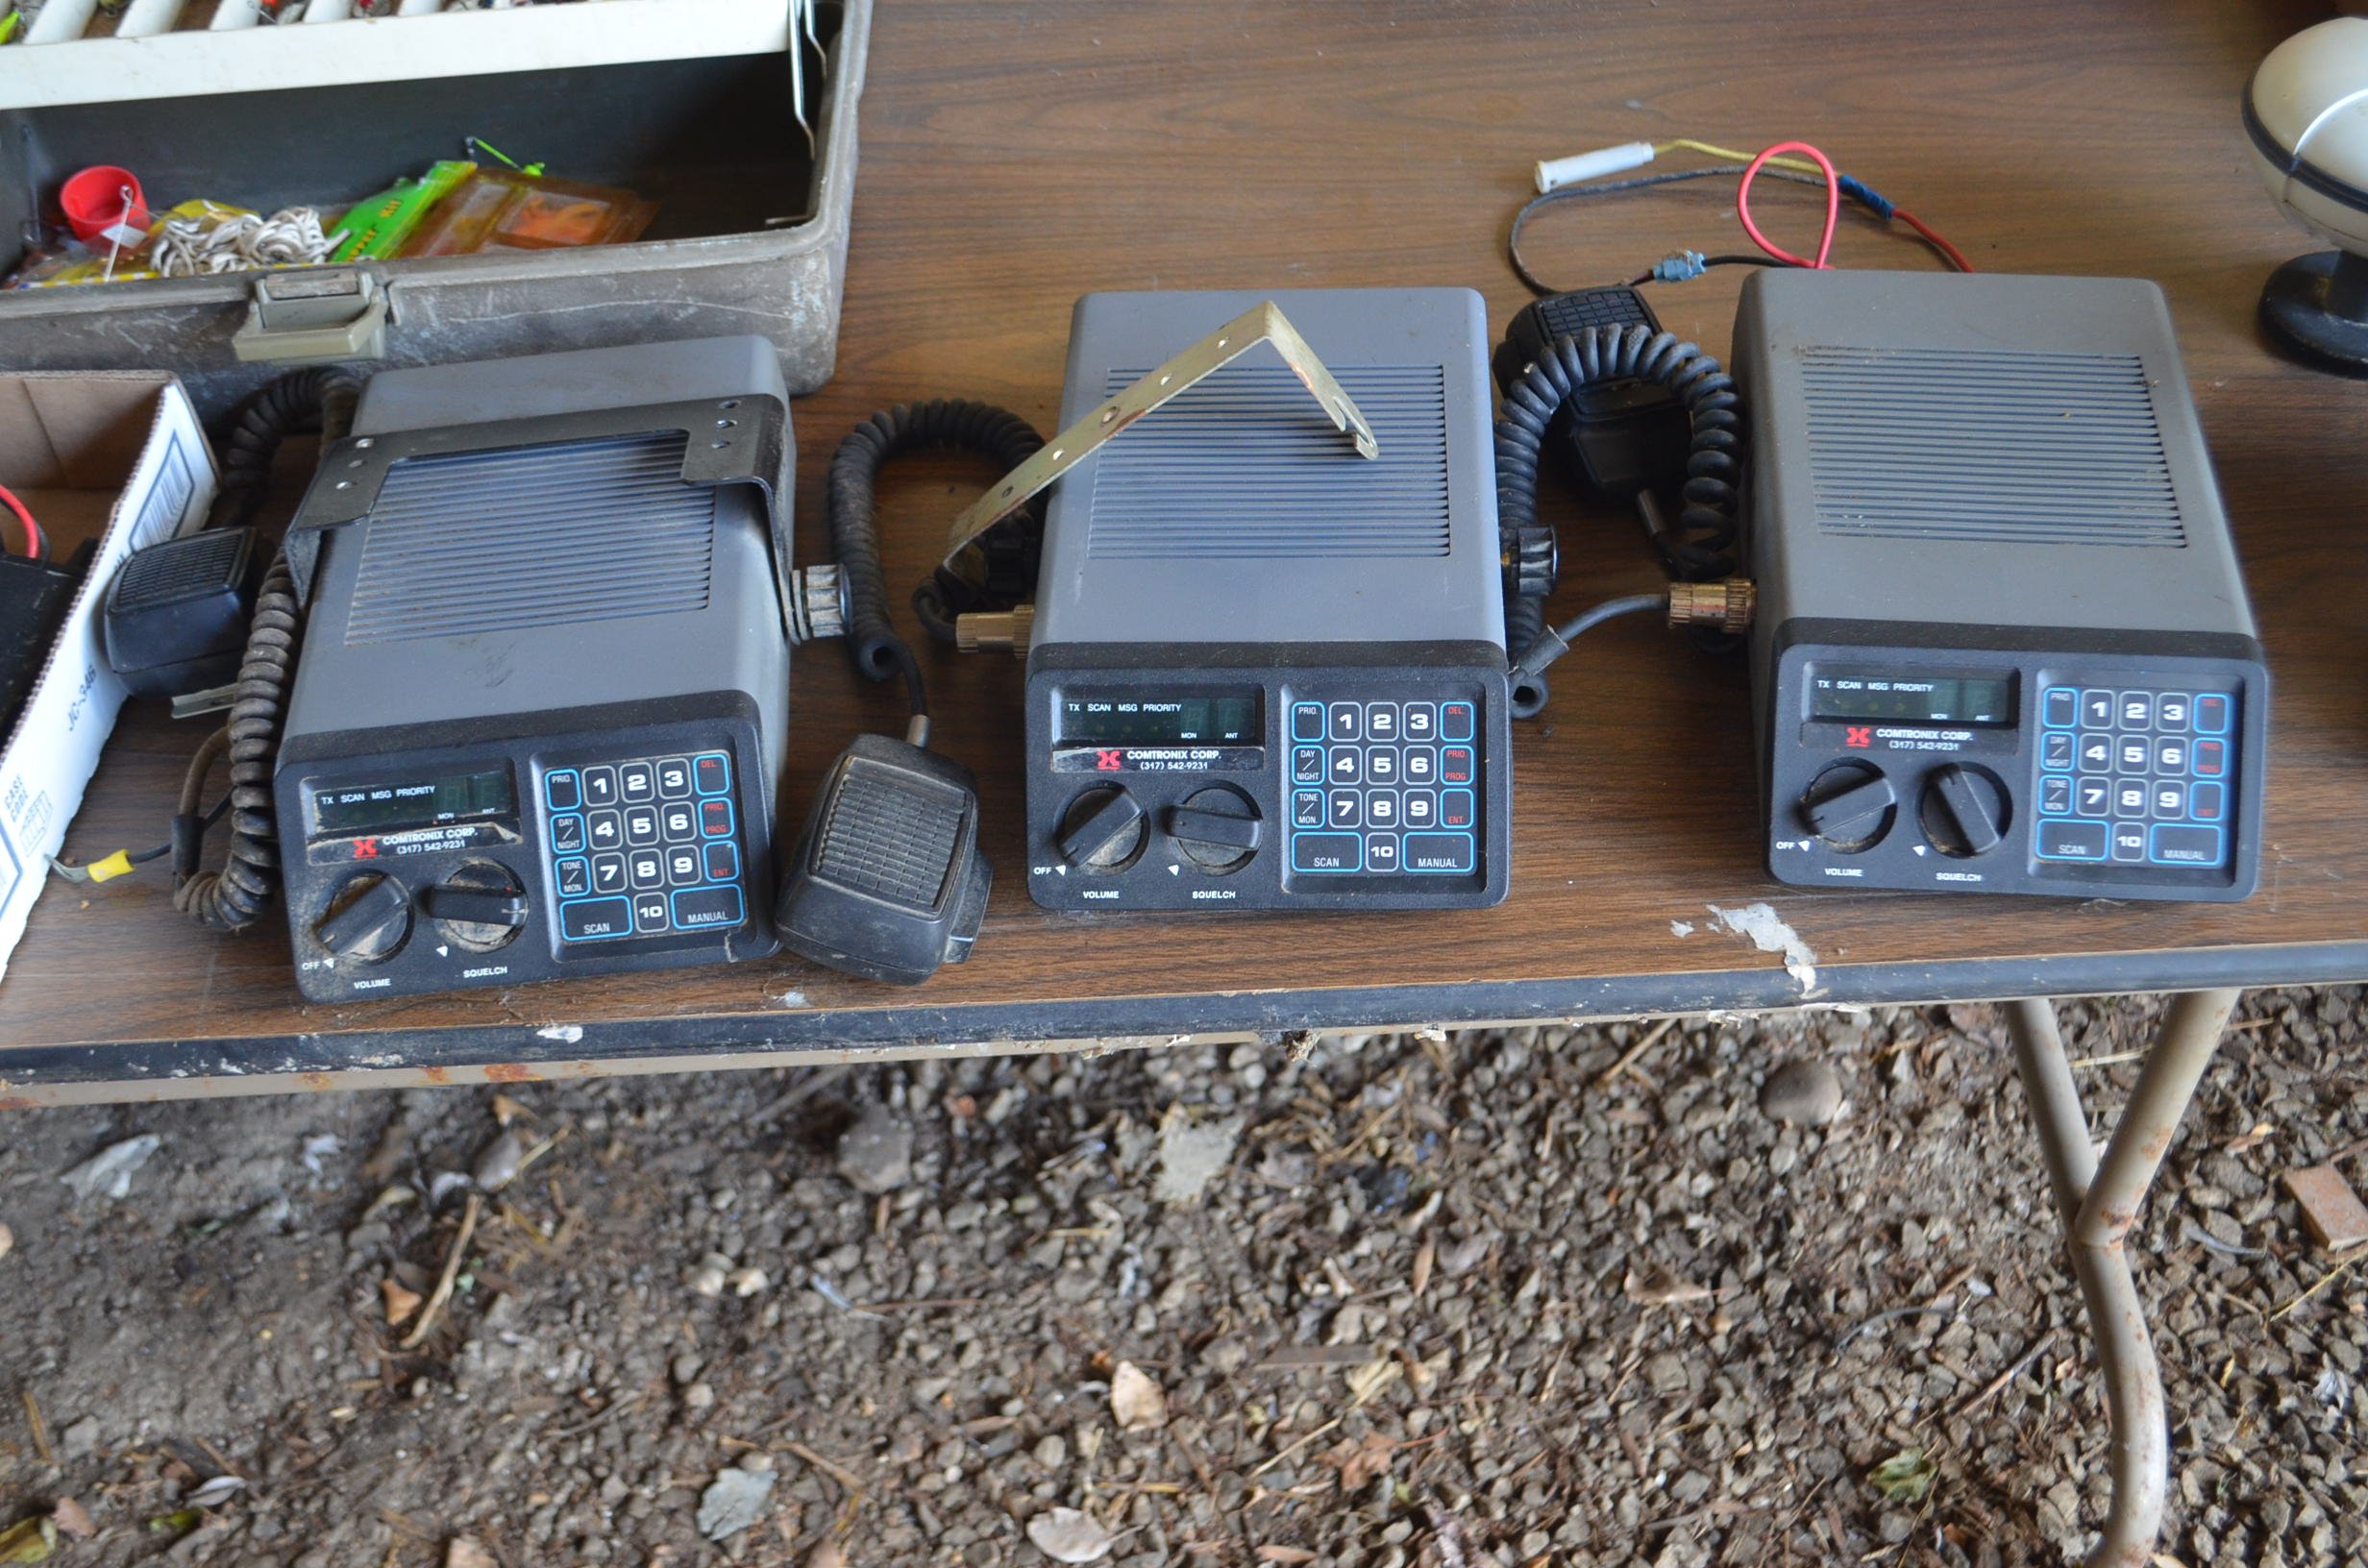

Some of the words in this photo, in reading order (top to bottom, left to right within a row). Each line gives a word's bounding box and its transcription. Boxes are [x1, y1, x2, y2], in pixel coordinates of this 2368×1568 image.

[1817, 680, 1830, 689] TX
[1837, 680, 1862, 690] SCAN
[1867, 682, 1889, 691] MSG
[1892, 682, 1934, 693] PRIORITY
[1068, 703, 1080, 712] TX
[1087, 703, 1112, 712] SCAN
[1118, 703, 1138, 712] MSG
[1143, 703, 1181, 712] PRIORITY
[2091, 701, 2107, 718] 1
[2126, 702, 2146, 720] 2
[2163, 704, 2184, 721] 3
[1339, 714, 1352, 730] 1
[1373, 714, 1392, 730] 2
[1410, 714, 1429, 730] 3
[1876, 728, 1939, 741] COMTRONIX
[1940, 730, 1974, 742] CORP.
[1888, 740, 1914, 750] (317)
[1916, 741, 1960, 751] 542-9231
[1126, 750, 1188, 760] COMTRONIX
[1191, 750, 1221, 760] CORP.
[1300, 749, 1316, 758] DAY
[2085, 746, 2107, 761] 4
[2124, 747, 2144, 763] 5
[2161, 748, 2182, 765] 6
[1140, 761, 1164, 771] (317)
[1167, 761, 1208, 771] 542-9231
[1336, 757, 1355, 773] 4
[1373, 757, 1392, 773] 5
[1410, 757, 1429, 773] 6
[628, 774, 647, 791] 2
[664, 771, 683, 787] 3
[1296, 772, 1320, 781] NIGHT
[593, 777, 607, 794] 1
[321, 796, 334, 805] TX
[340, 793, 365, 803] SCAN
[371, 790, 392, 800] MSG
[396, 785, 435, 797] PRIORITY
[1298, 793, 1319, 801] TONE
[2084, 789, 2105, 804] 7
[2121, 791, 2142, 807] 8
[2158, 792, 2180, 808] 9
[1336, 800, 1354, 817] 7
[1373, 800, 1392, 817] 8
[1410, 800, 1429, 817] 9
[632, 818, 652, 834] 5
[669, 814, 688, 830] 6
[1298, 816, 1318, 824] MON.
[382, 831, 445, 845] COMTRONIX
[446, 827, 479, 840] CORP.
[595, 821, 615, 837] 4
[396, 843, 422, 855] (317)
[424, 840, 466, 852] 542-9231
[1776, 842, 1795, 850] OFF
[2117, 836, 2141, 847] 10
[1370, 845, 1394, 858] 10
[2059, 845, 2086, 854] SCAN
[636, 861, 656, 877] 8
[674, 857, 693, 873] 9
[1314, 857, 1340, 868] SCAN
[1418, 858, 1458, 869] MANUAL
[600, 865, 618, 881] 7
[1033, 867, 1051, 875] OFF
[1825, 868, 1863, 877] VOLUME
[1936, 872, 1982, 883] SQUELCH
[1083, 891, 1120, 899] VOLUME
[1192, 891, 1236, 899] SQUELCH
[639, 905, 663, 919] 10
[687, 911, 728, 923] MANUAL
[583, 922, 610, 935] SCAN
[302, 962, 320, 970] OFF
[463, 967, 507, 978] SQUELCH
[354, 978, 391, 990] VOLUME
